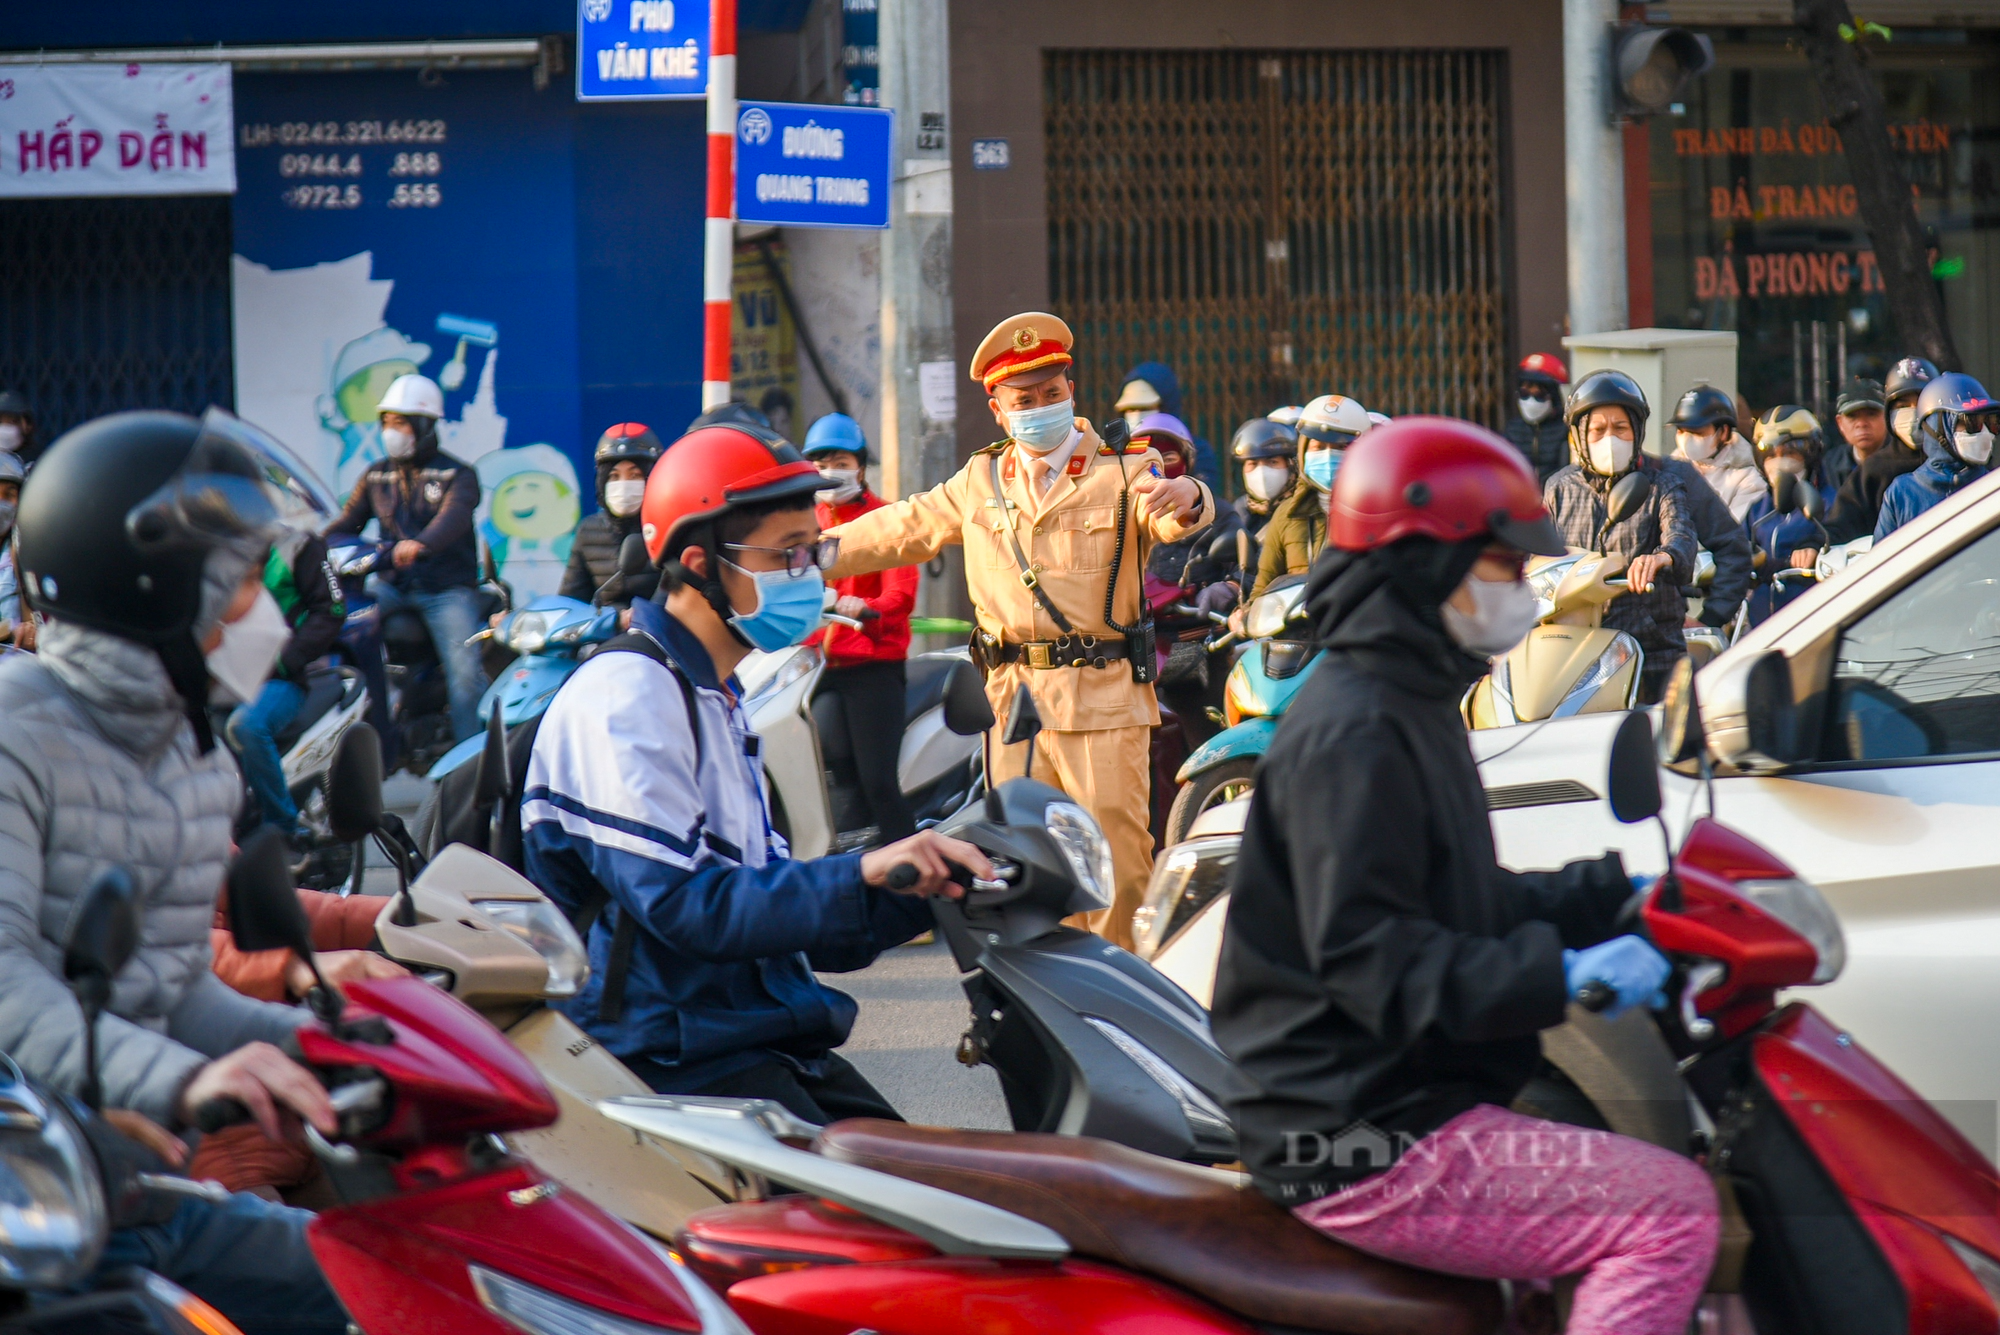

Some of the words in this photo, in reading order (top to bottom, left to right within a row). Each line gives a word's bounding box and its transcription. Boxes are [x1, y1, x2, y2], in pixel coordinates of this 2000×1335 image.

[597, 41, 648, 81] VĂN
[650, 38, 699, 79] KHÊ
[18, 114, 103, 173] HẤP
[119, 112, 208, 172] DẪN
[782, 119, 844, 161] ĐƯỜNG
[973, 141, 1008, 165] 563
[1672, 128, 1755, 156] TRANH
[1759, 117, 1795, 154] ĐÁ
[756, 173, 814, 204] QUANG
[815, 176, 870, 207] TRUNG
[1711, 176, 1753, 219] ĐÁ
[1758, 184, 1858, 218] TRANG
[1695, 239, 1741, 298] ĐÁ
[1746, 252, 1850, 297] PHONG
